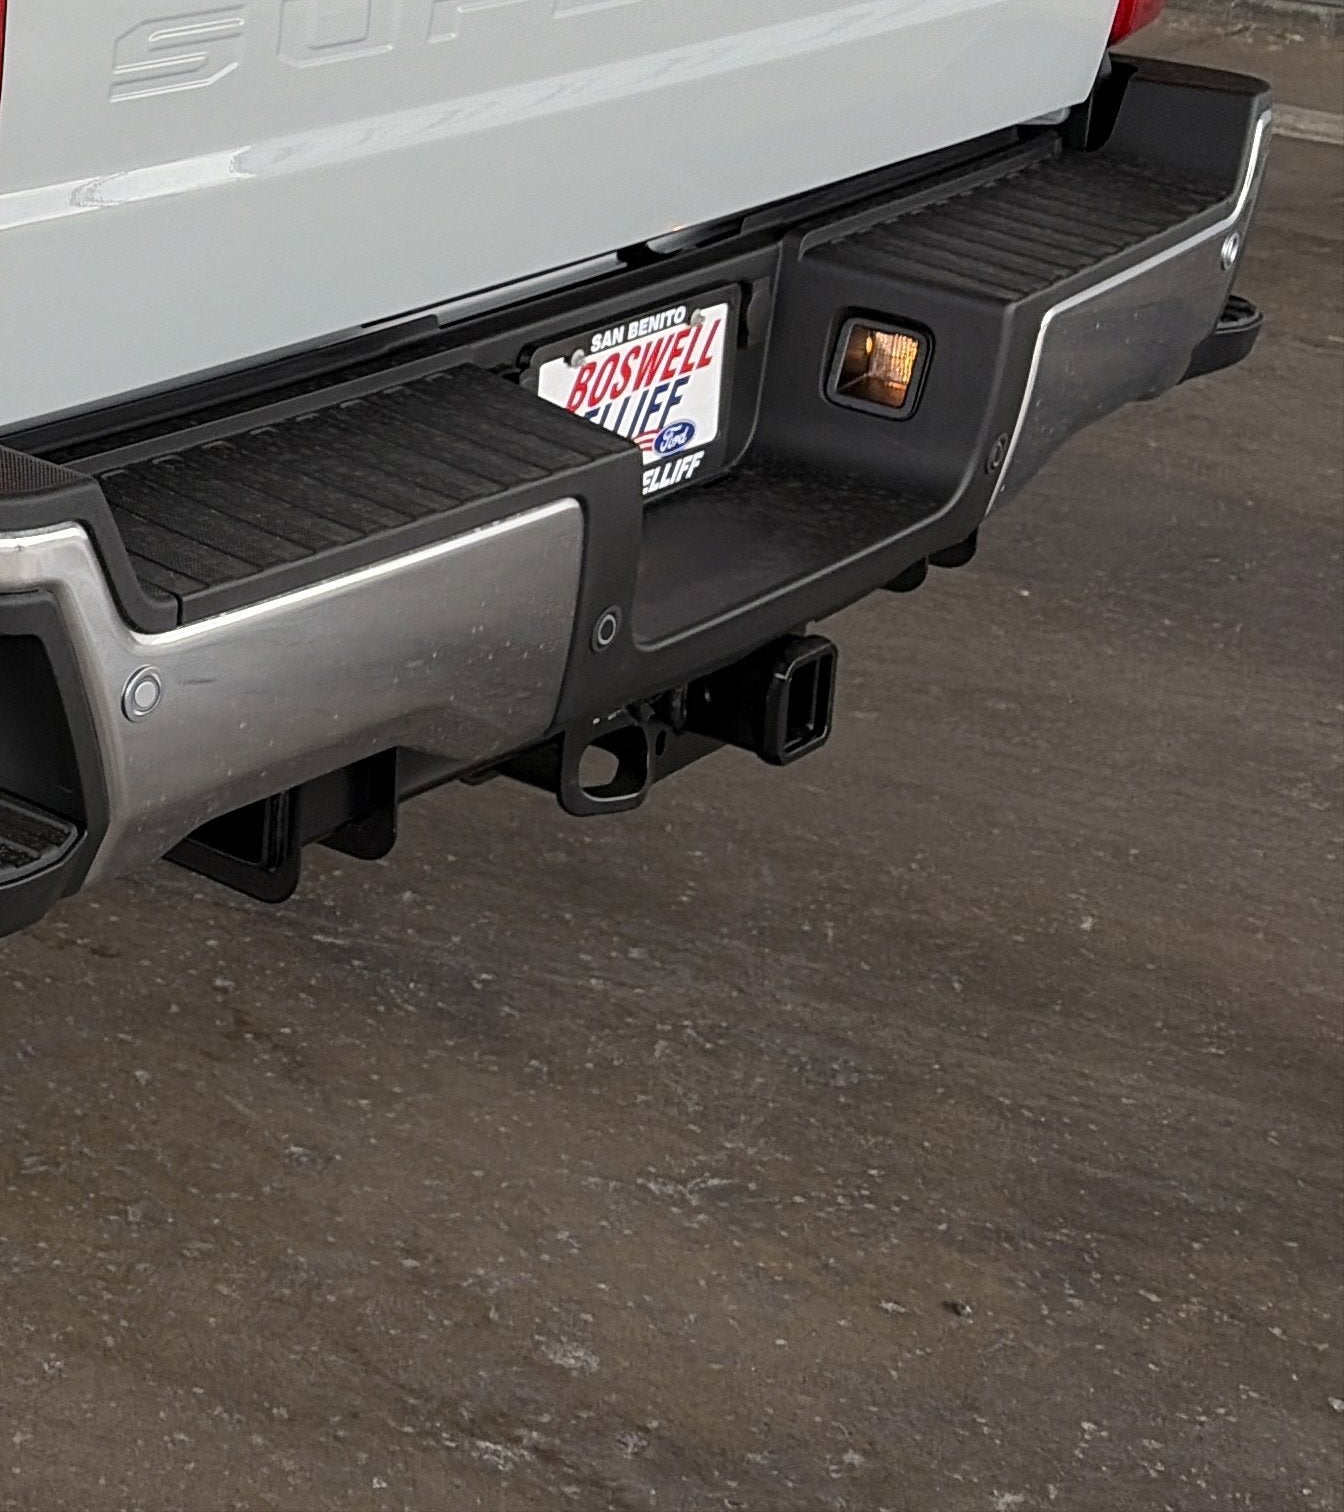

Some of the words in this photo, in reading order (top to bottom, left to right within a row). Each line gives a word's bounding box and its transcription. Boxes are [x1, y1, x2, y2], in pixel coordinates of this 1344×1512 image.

[590, 325, 625, 353] SAN
[627, 305, 687, 340] BENITO
[566, 318, 722, 414] BOSWELL
[657, 424, 691, 453] Ford
